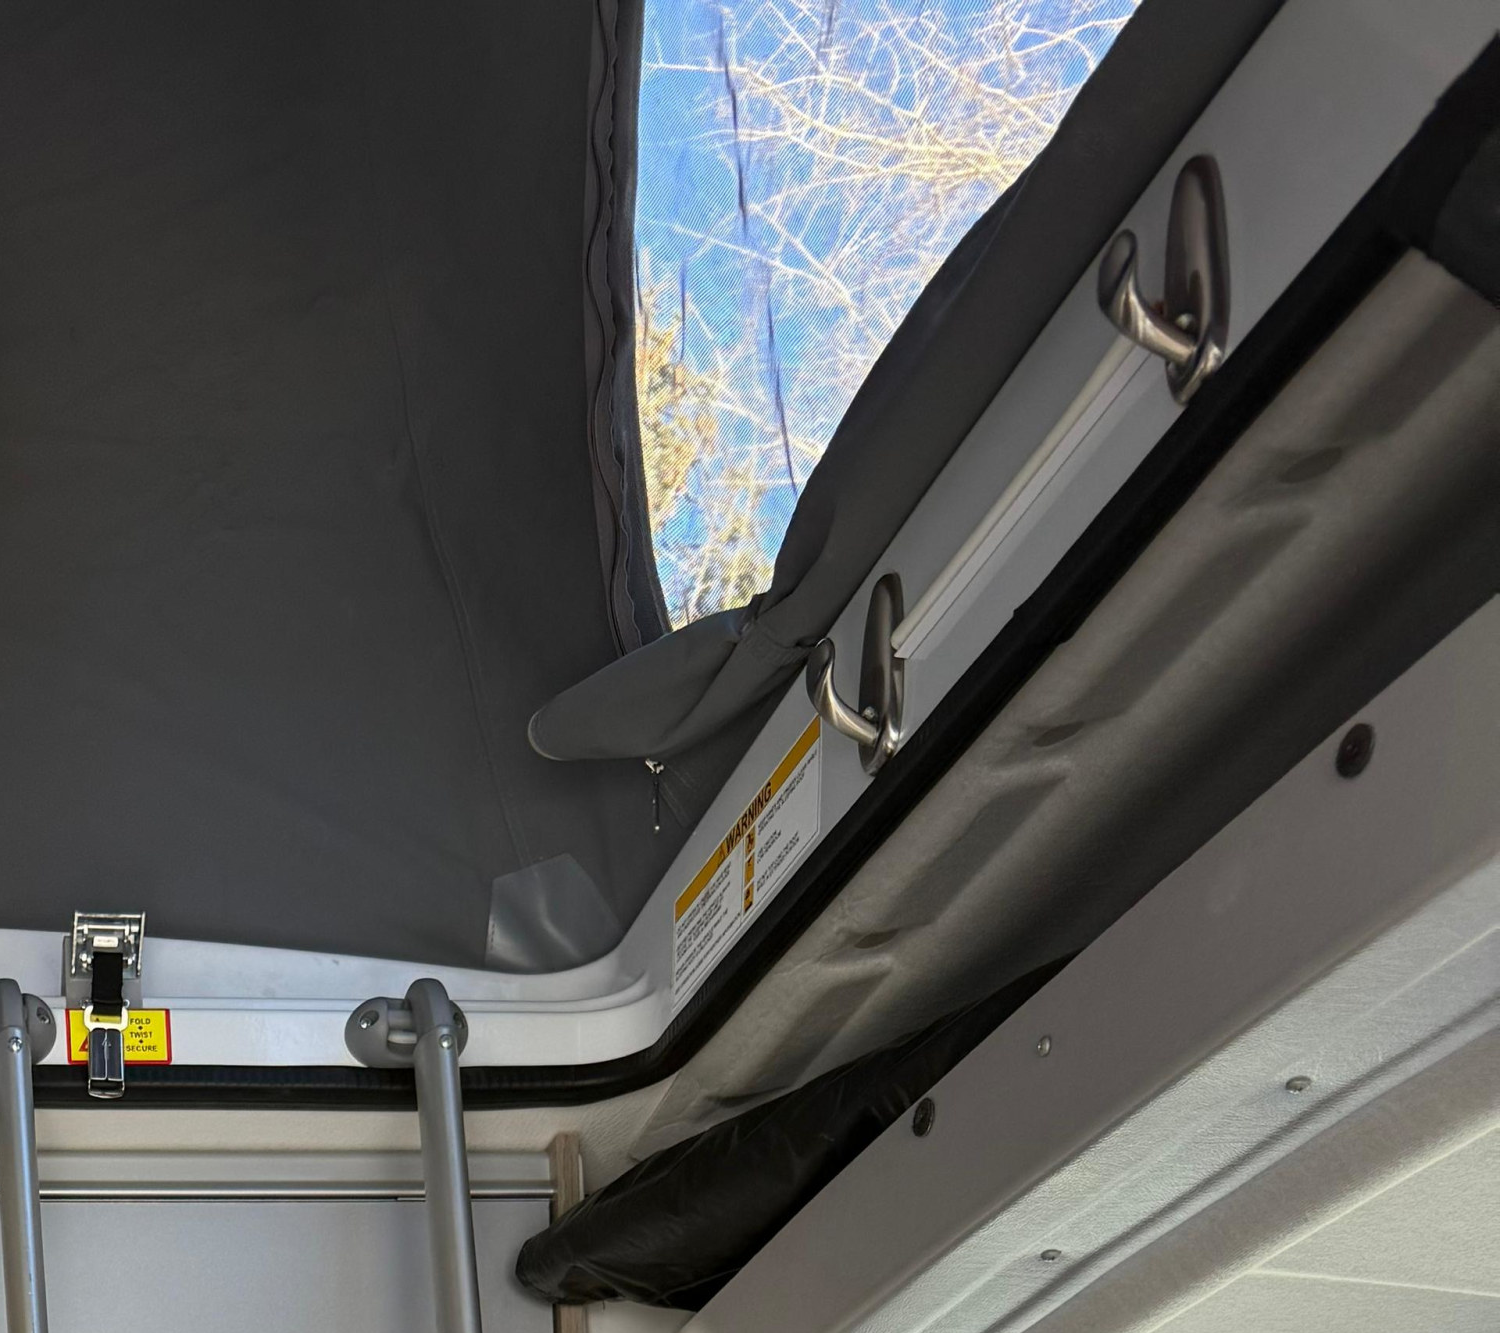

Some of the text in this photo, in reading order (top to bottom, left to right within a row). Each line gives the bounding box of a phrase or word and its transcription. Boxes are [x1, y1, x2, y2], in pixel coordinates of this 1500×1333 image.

[725, 781, 772, 854] WARNING
[129, 1017, 151, 1025] FOLD
[130, 1031, 153, 1039] TWIST
[126, 1045, 158, 1053] SECURE
